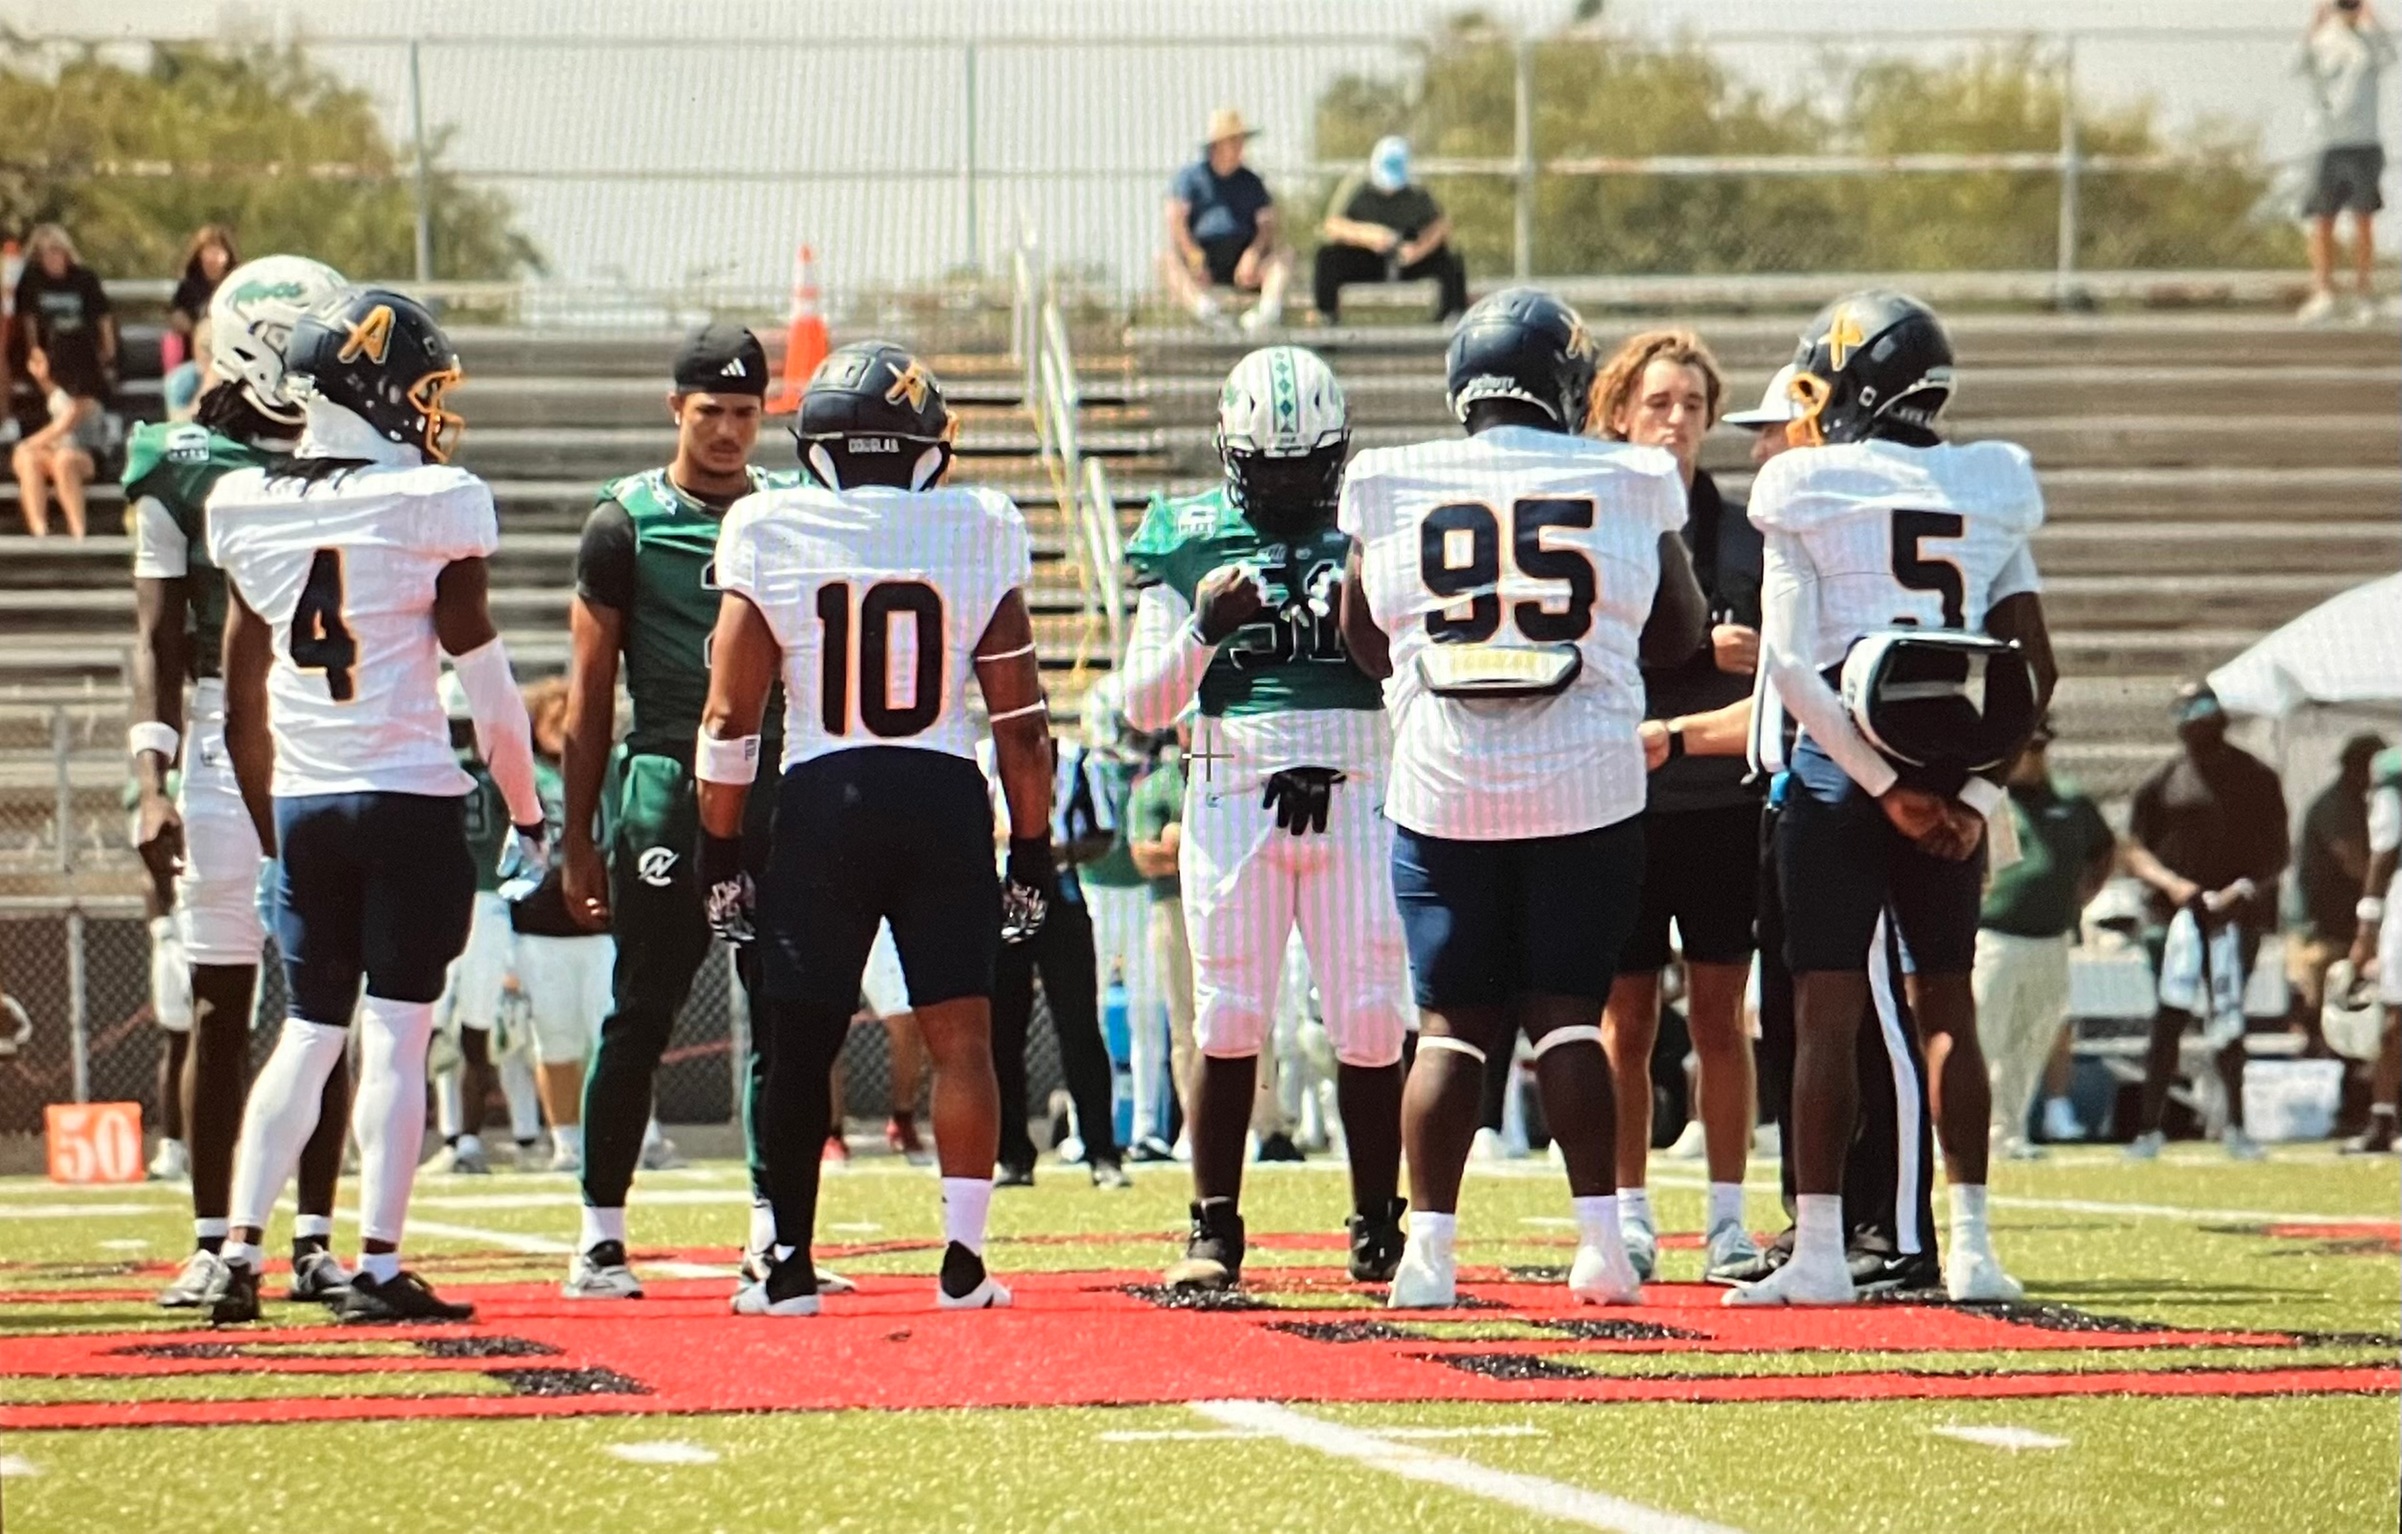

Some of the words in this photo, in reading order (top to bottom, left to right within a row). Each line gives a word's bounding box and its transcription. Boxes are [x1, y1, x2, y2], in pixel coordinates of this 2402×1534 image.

[289, 547, 360, 704] 4
[1420, 497, 1597, 643] 95
[1890, 508, 1966, 629] 5
[817, 580, 946, 738] 10
[57, 1110, 138, 1181] 50
